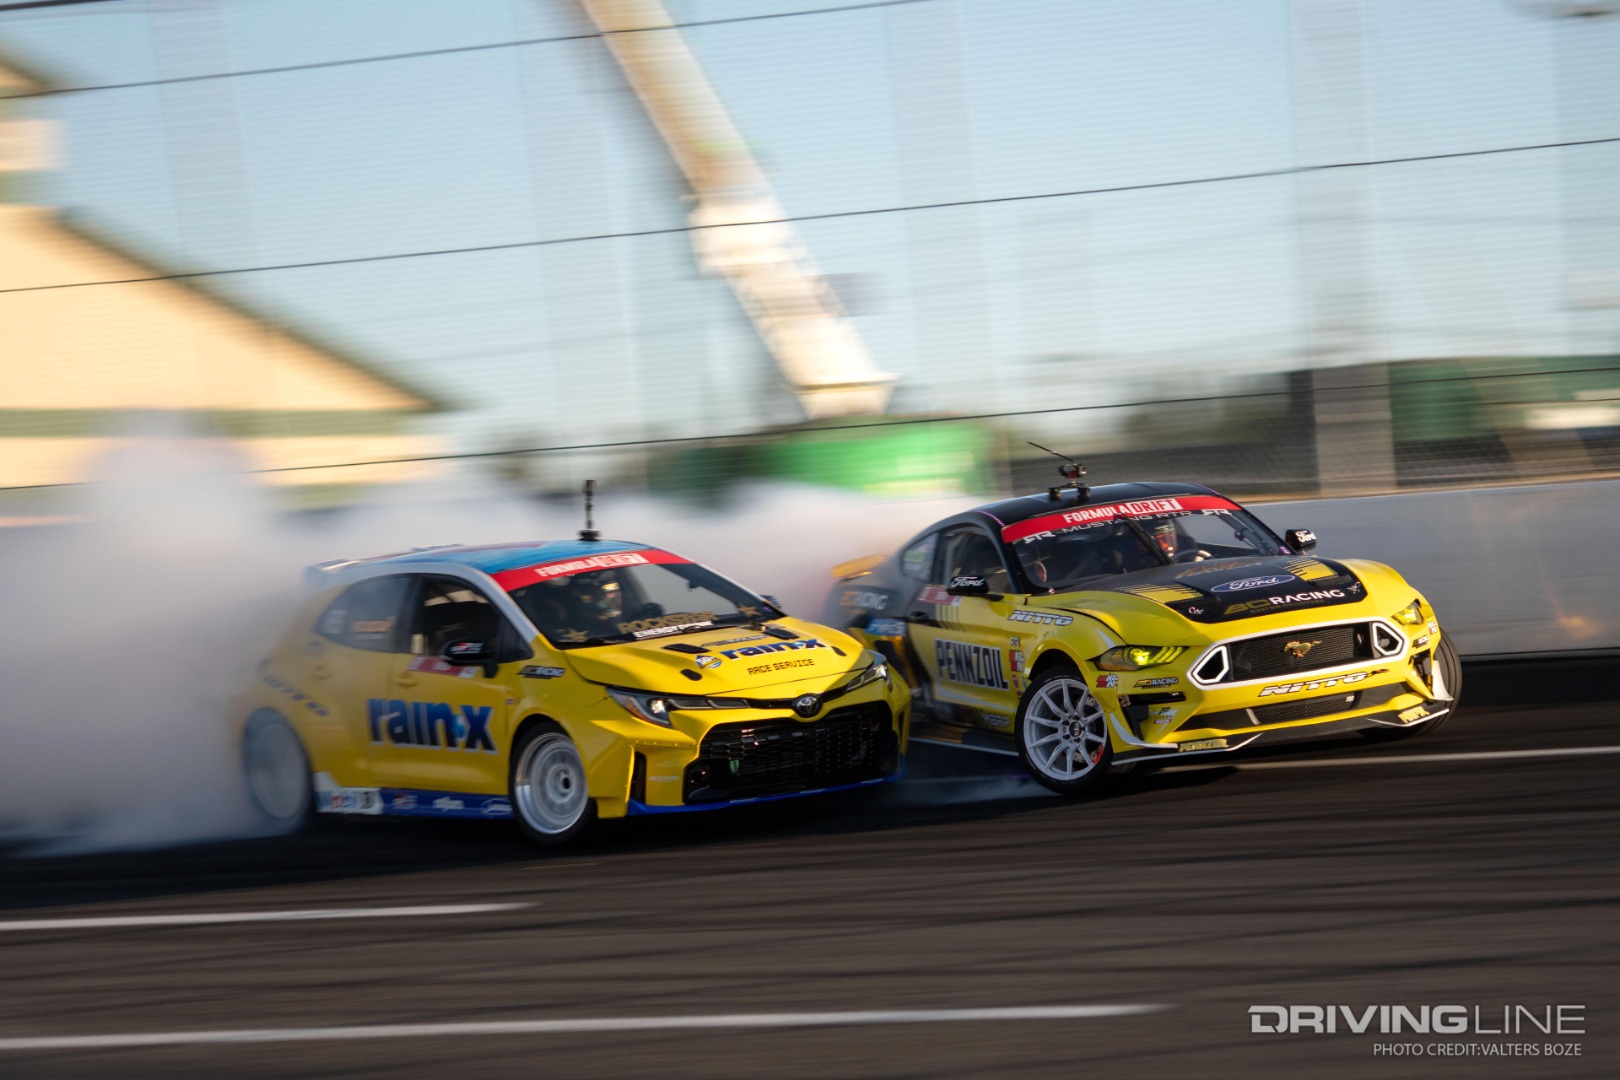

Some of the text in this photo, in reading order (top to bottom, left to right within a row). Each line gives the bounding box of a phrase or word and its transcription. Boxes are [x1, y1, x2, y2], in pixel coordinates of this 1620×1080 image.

[1062, 498, 1184, 523] FORMULA DRIFT
[950, 576, 986, 588] Ford
[1229, 577, 1280, 590] Ford
[1268, 589, 1346, 605] RACING
[1009, 609, 1075, 627] NITTO
[747, 658, 816, 675] RACE SERVICE
[935, 638, 1009, 691] PENNZOIL
[1258, 671, 1368, 697] NITTO
